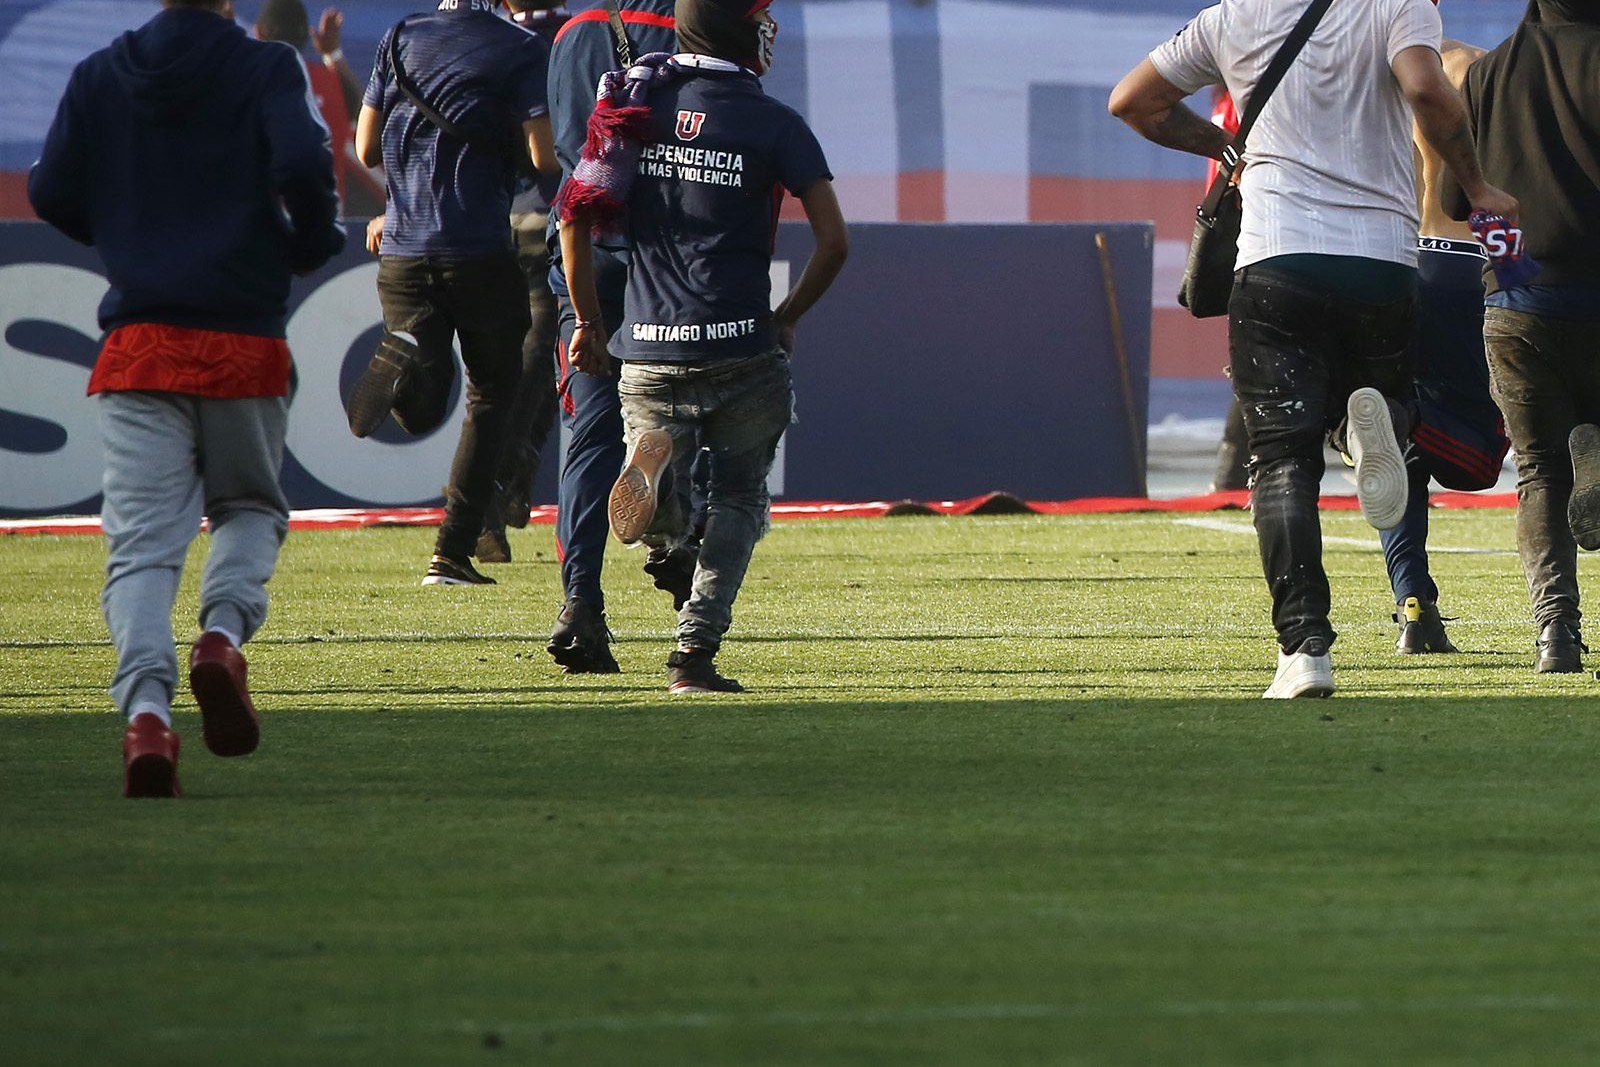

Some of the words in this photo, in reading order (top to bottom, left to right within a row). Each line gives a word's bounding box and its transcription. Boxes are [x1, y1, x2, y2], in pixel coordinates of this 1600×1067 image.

[675, 110, 707, 142] U
[648, 162, 673, 178] MAS
[677, 166, 742, 188] VIOLENCIA
[632, 322, 700, 342] SANTIAGO
[706, 318, 755, 340] NORTE
